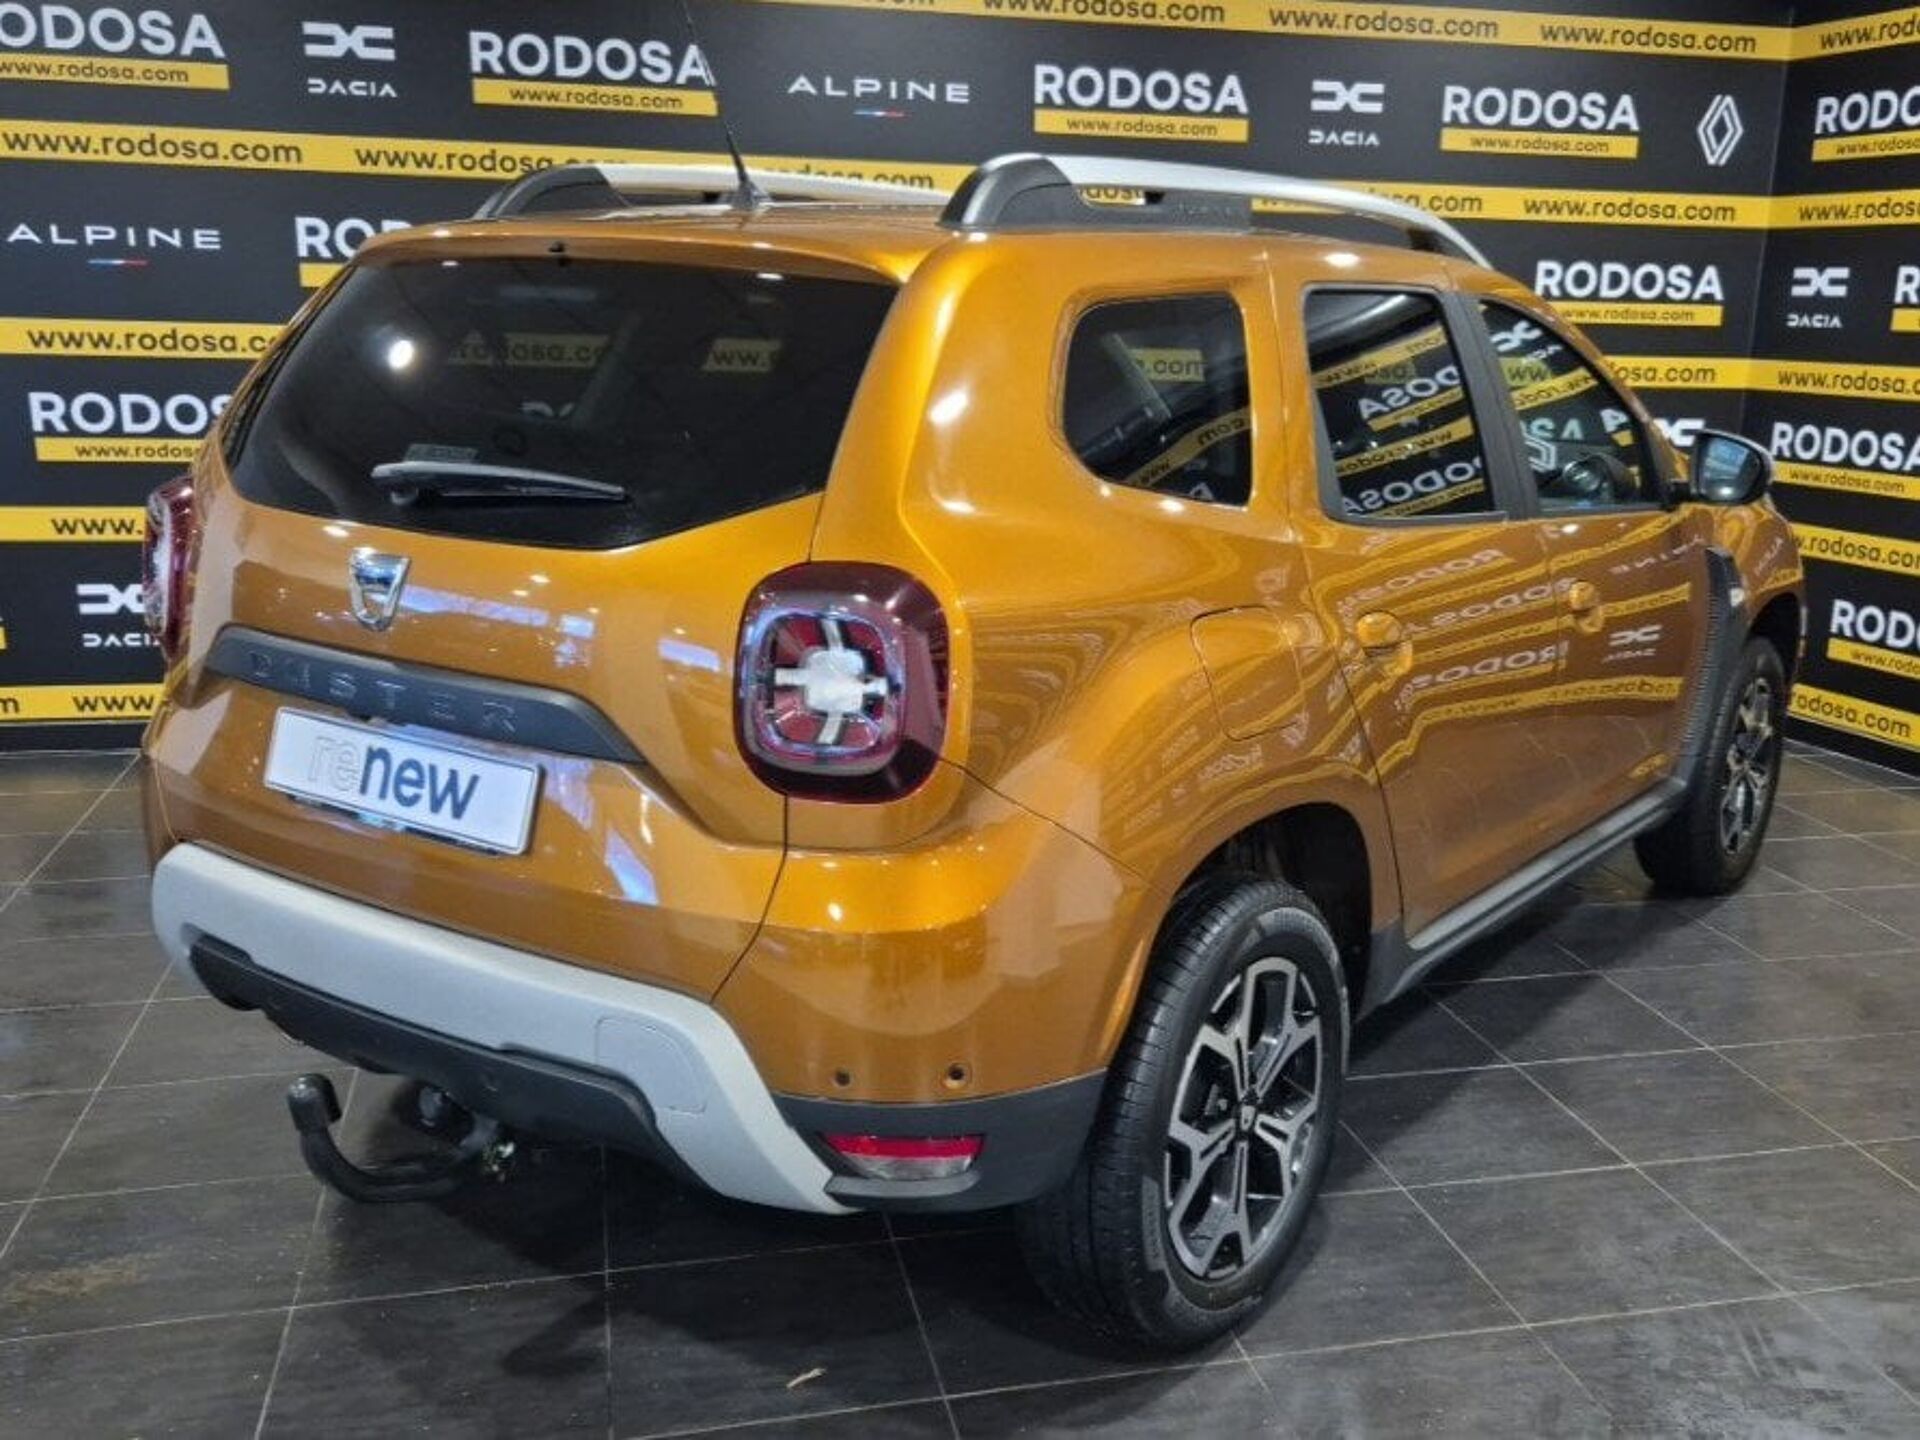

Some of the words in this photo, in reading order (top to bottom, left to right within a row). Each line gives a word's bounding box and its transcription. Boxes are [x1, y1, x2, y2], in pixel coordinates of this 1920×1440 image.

[1269, 8, 1499, 38] www.rodosa.com
[1541, 23, 1756, 53] www.rodosa.com
[469, 30, 716, 87] RODOSA
[307, 77, 397, 98] DACIA
[508, 86, 683, 109] www.rodosa.com
[787, 75, 970, 104] ALPINE
[1034, 63, 1248, 114] RODOSA
[1442, 84, 1639, 132] RODOSA
[1066, 116, 1218, 136] www.rodosa.com
[3, 132, 303, 163] www.rodosa.com
[1470, 135, 1609, 155] www.rodosa.com
[1524, 197, 1736, 222] www.rodosa.com
[7, 223, 222, 250] ALPINE
[295, 216, 411, 259] RO
[1535, 260, 1723, 300] RODOSA
[28, 328, 276, 352] www.rodosa.c
[1830, 599, 1920, 650] ROD
[1795, 693, 1911, 738] odosa.com
[308, 735, 480, 820] renew
